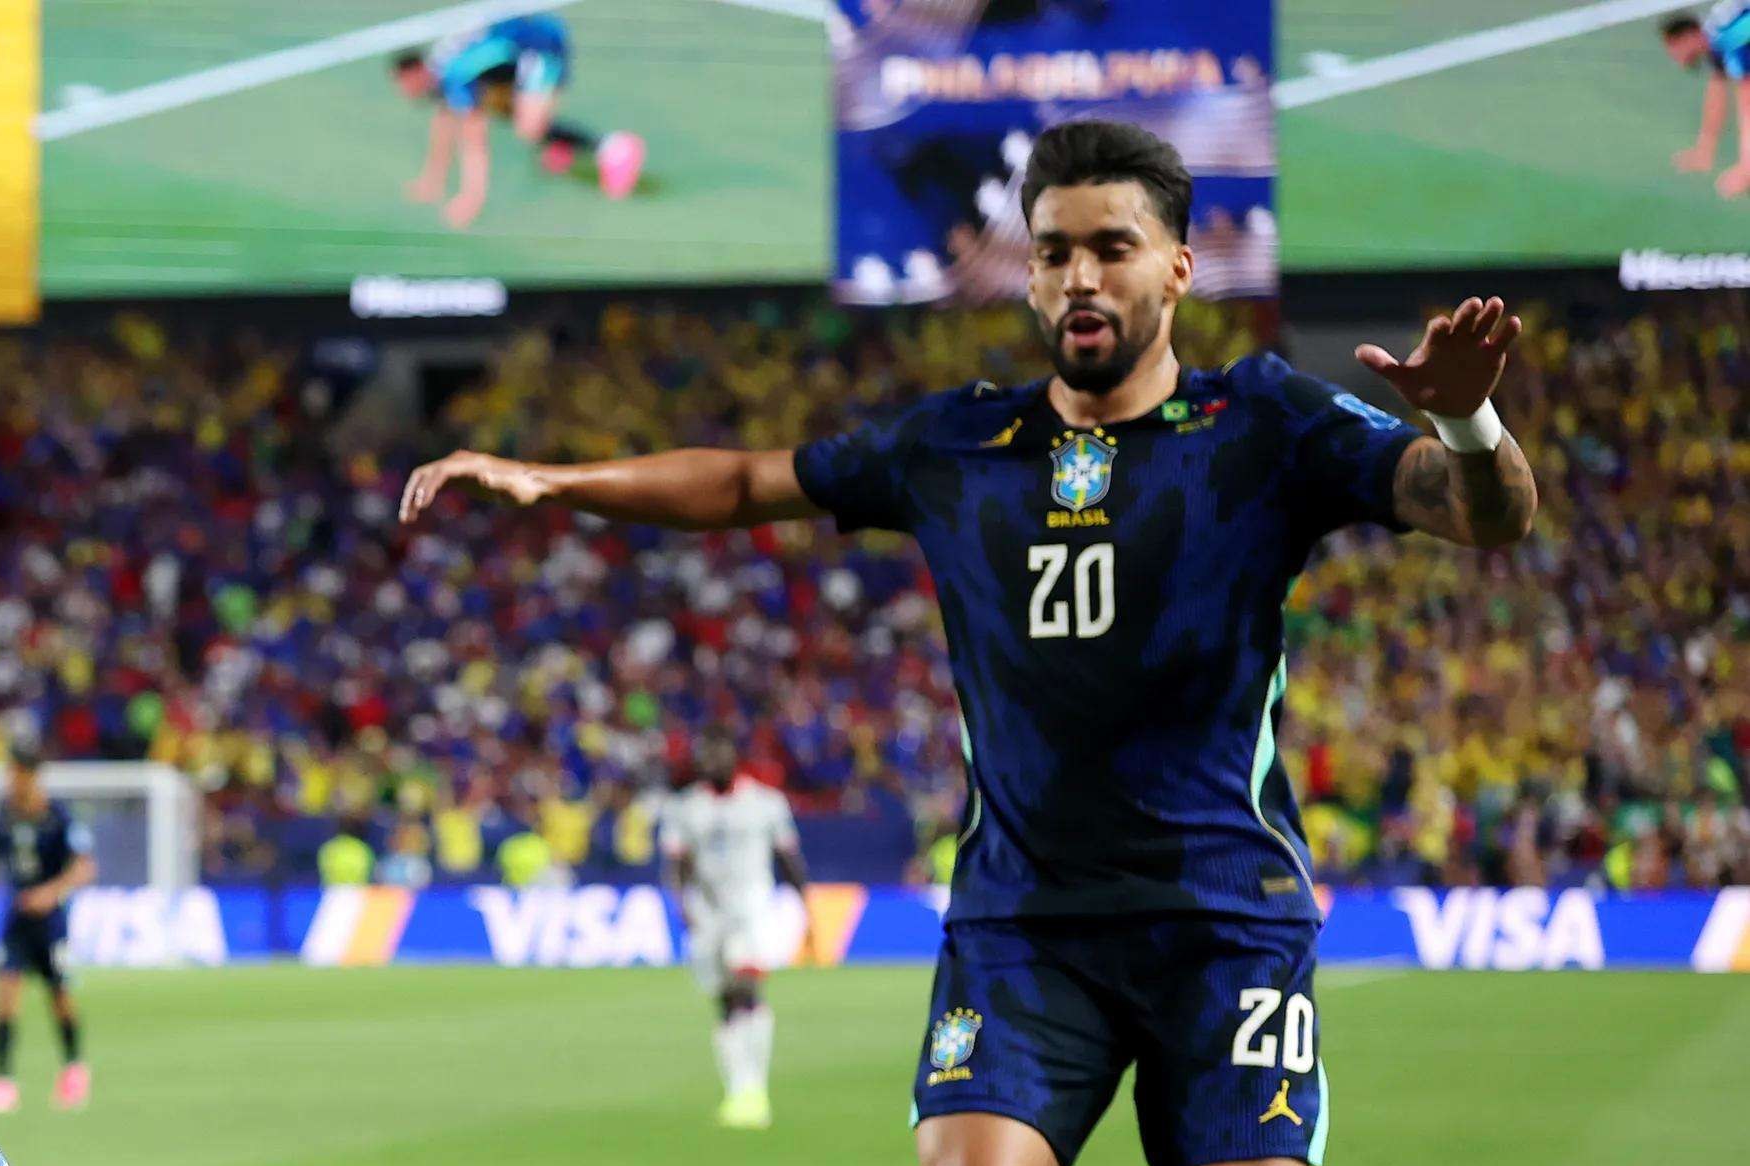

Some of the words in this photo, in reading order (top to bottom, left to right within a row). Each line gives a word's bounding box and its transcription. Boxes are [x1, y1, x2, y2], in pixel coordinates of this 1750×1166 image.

[1047, 508, 1110, 528] BRASIL
[1028, 543, 1115, 639] 20
[472, 885, 674, 966] VISA
[1396, 887, 1605, 970] VISA
[1231, 987, 1315, 1073] 20
